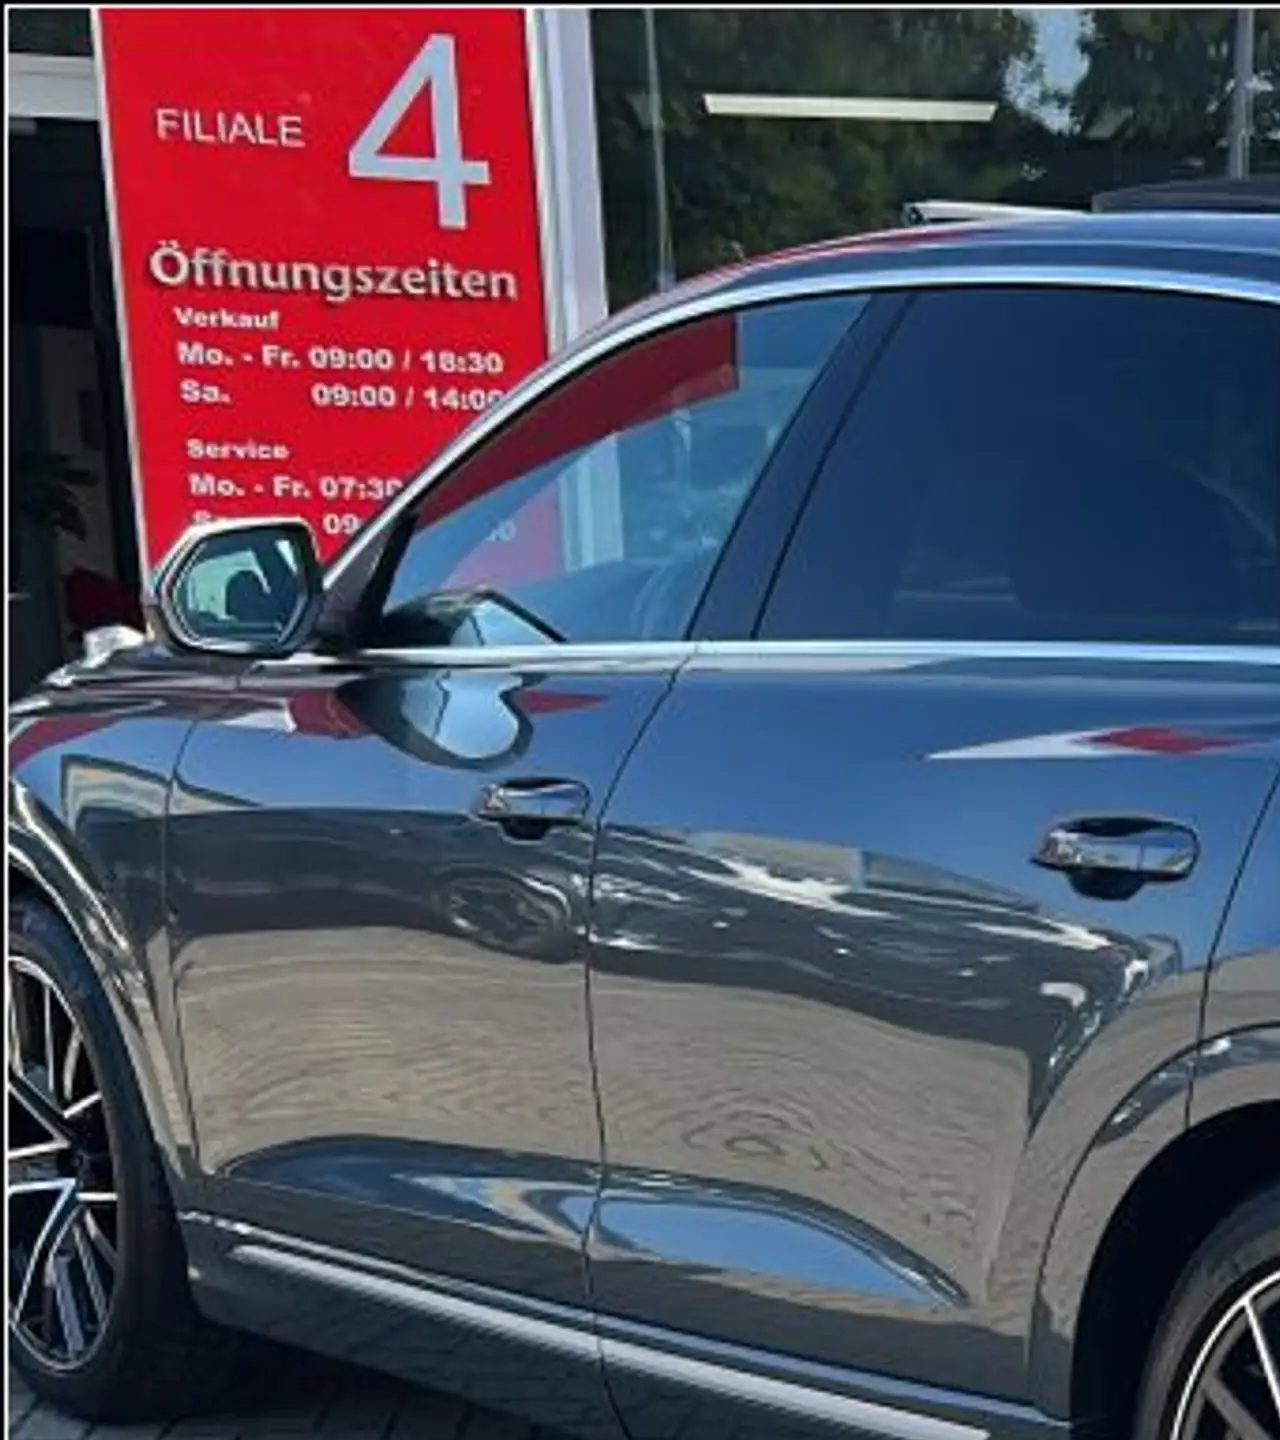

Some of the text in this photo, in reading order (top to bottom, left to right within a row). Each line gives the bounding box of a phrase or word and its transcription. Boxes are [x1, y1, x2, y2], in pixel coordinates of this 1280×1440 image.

[156, 33, 491, 230] FILIALE 4
[149, 240, 517, 301] Öffnungszeiten
[174, 306, 280, 330] Verkauf
[177, 341, 234, 368] Mo.
[261, 344, 301, 370] Fr.
[308, 347, 394, 371] 09:00
[180, 378, 232, 404] Sa.
[311, 383, 396, 409] 09:00
[186, 438, 290, 461] Service
[188, 473, 246, 498] Mo.
[272, 475, 312, 501] Fr.
